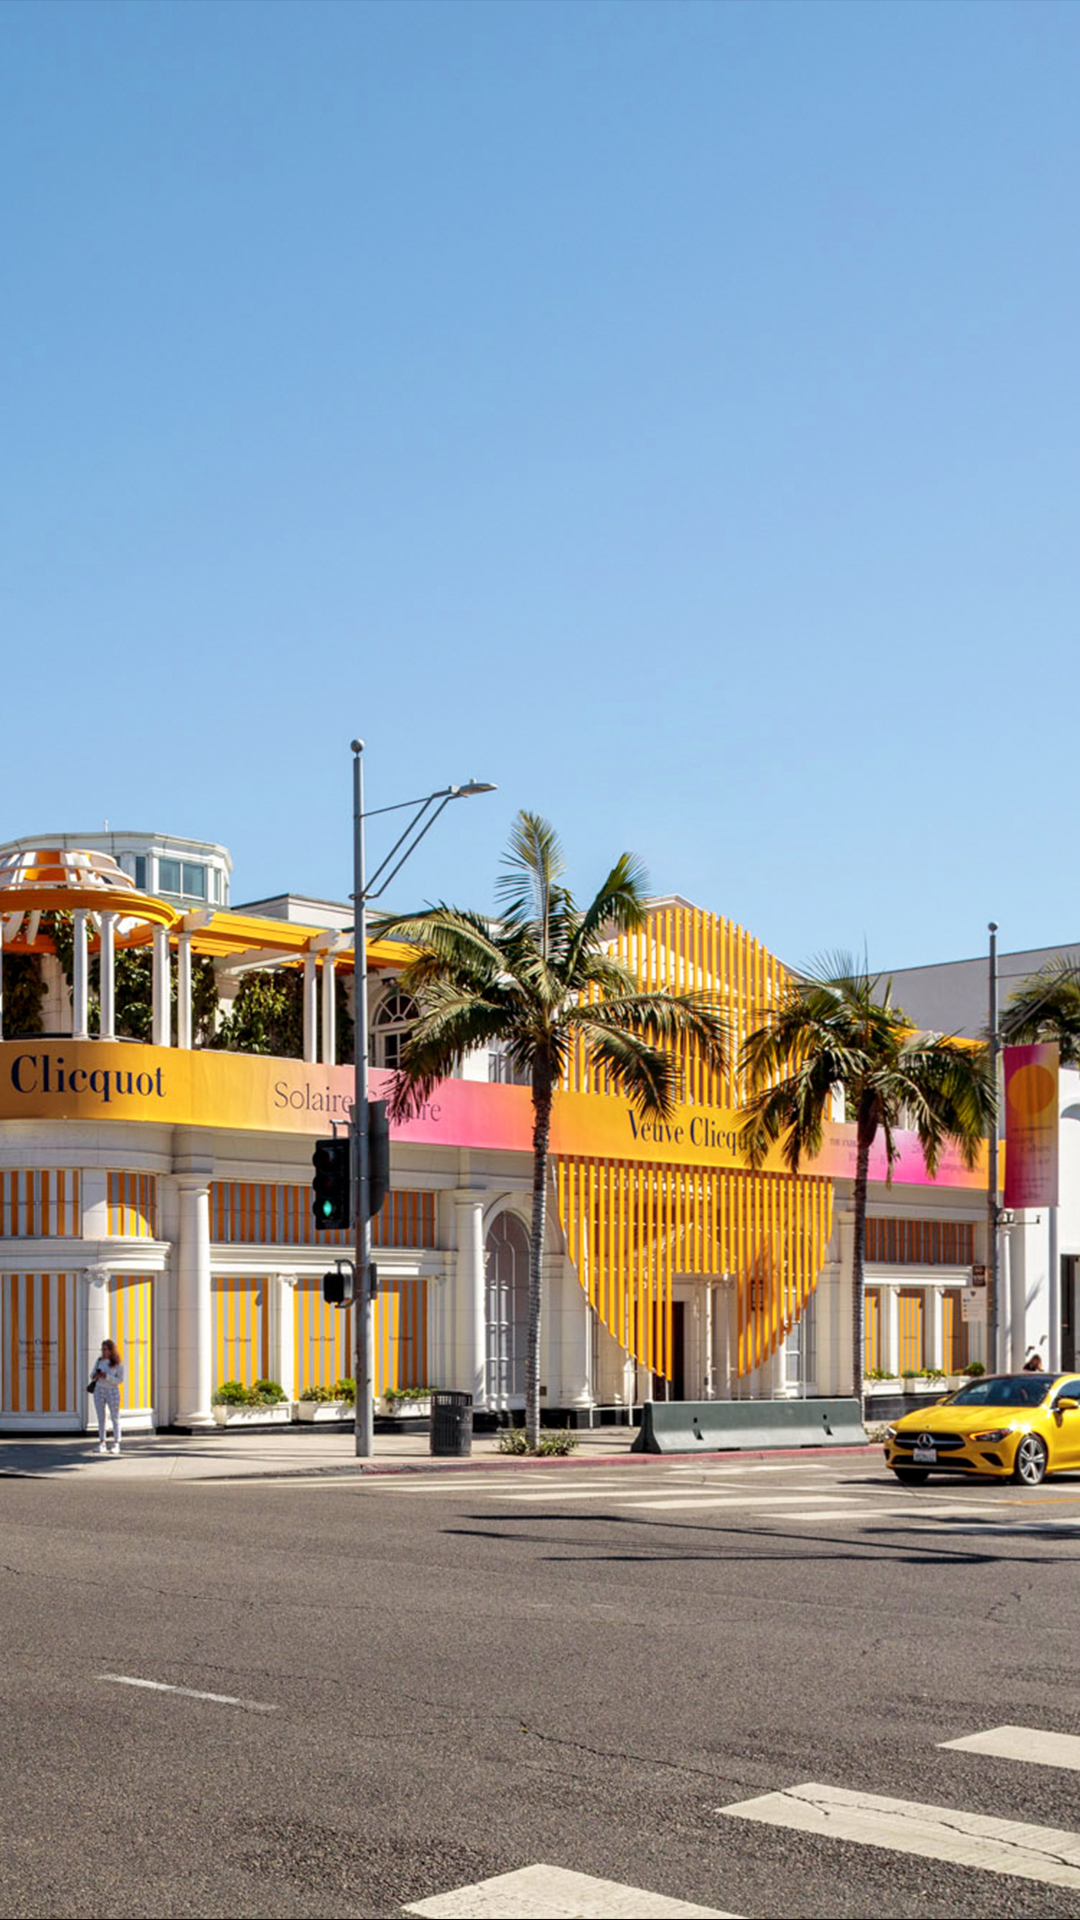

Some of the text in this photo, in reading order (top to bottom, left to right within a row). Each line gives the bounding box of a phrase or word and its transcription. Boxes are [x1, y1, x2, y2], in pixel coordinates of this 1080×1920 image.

[11, 1054, 167, 1102] Clicquot
[274, 1081, 354, 1114] Solaire
[627, 1110, 751, 1156] Veuve Clicqu
